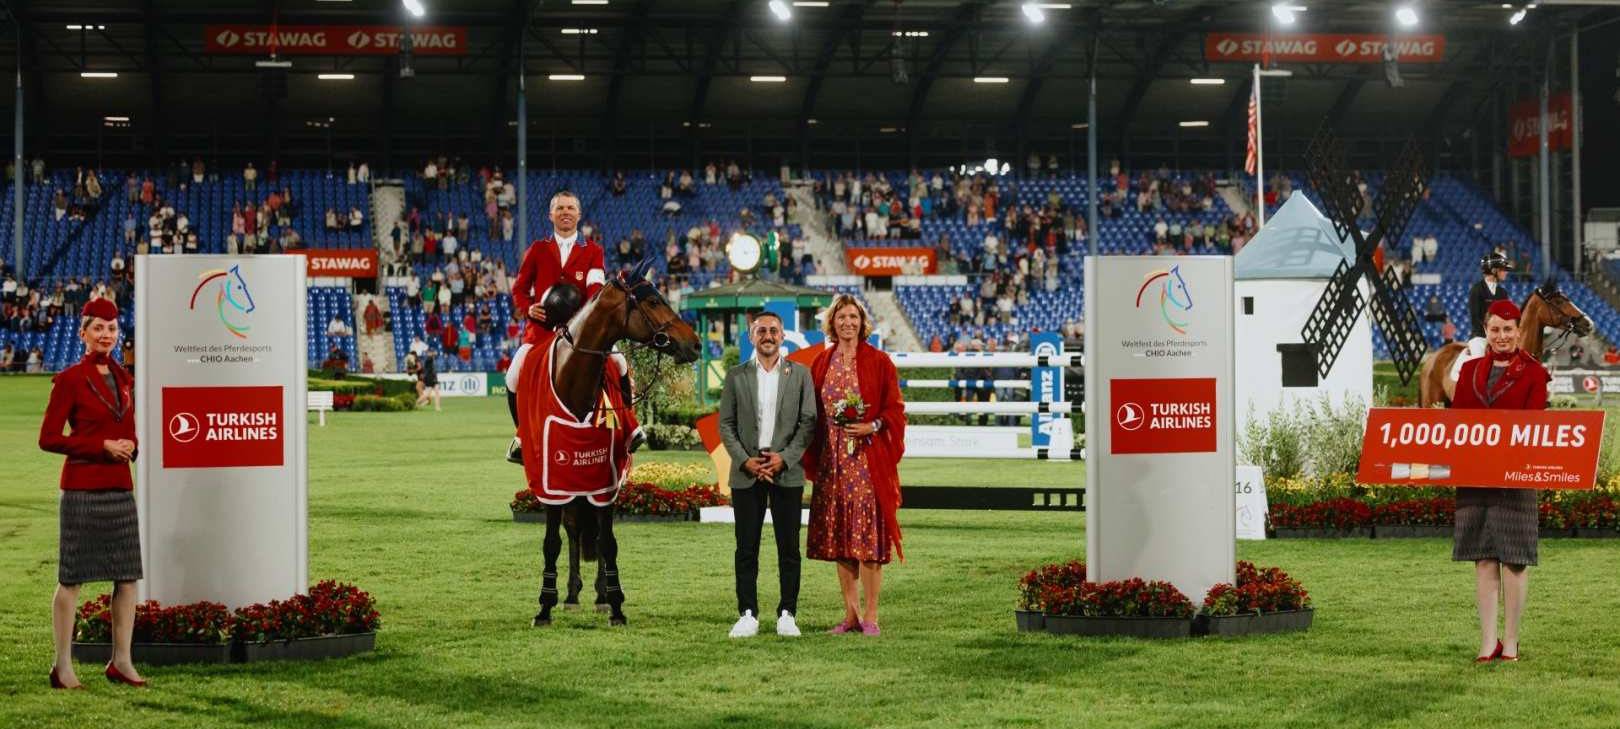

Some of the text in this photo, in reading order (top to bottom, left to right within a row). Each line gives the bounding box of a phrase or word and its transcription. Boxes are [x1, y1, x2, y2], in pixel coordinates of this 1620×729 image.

[244, 32, 326, 46] STAWAG
[1241, 40, 1318, 55] STAWAG
[311, 257, 371, 270] STAWAG
[200, 354, 254, 363] CHIO Aachen
[1145, 349, 1165, 358] CHIO
[1150, 402, 1211, 416] TURKISH
[205, 412, 277, 426] TURKISH
[1149, 416, 1212, 429] AIRLINES
[205, 427, 278, 441] AIRLINES
[1379, 422, 1587, 449] 1,000,000 MILES
[573, 447, 608, 458] TURKISH
[1504, 471, 1581, 483] Miles&Smiles
